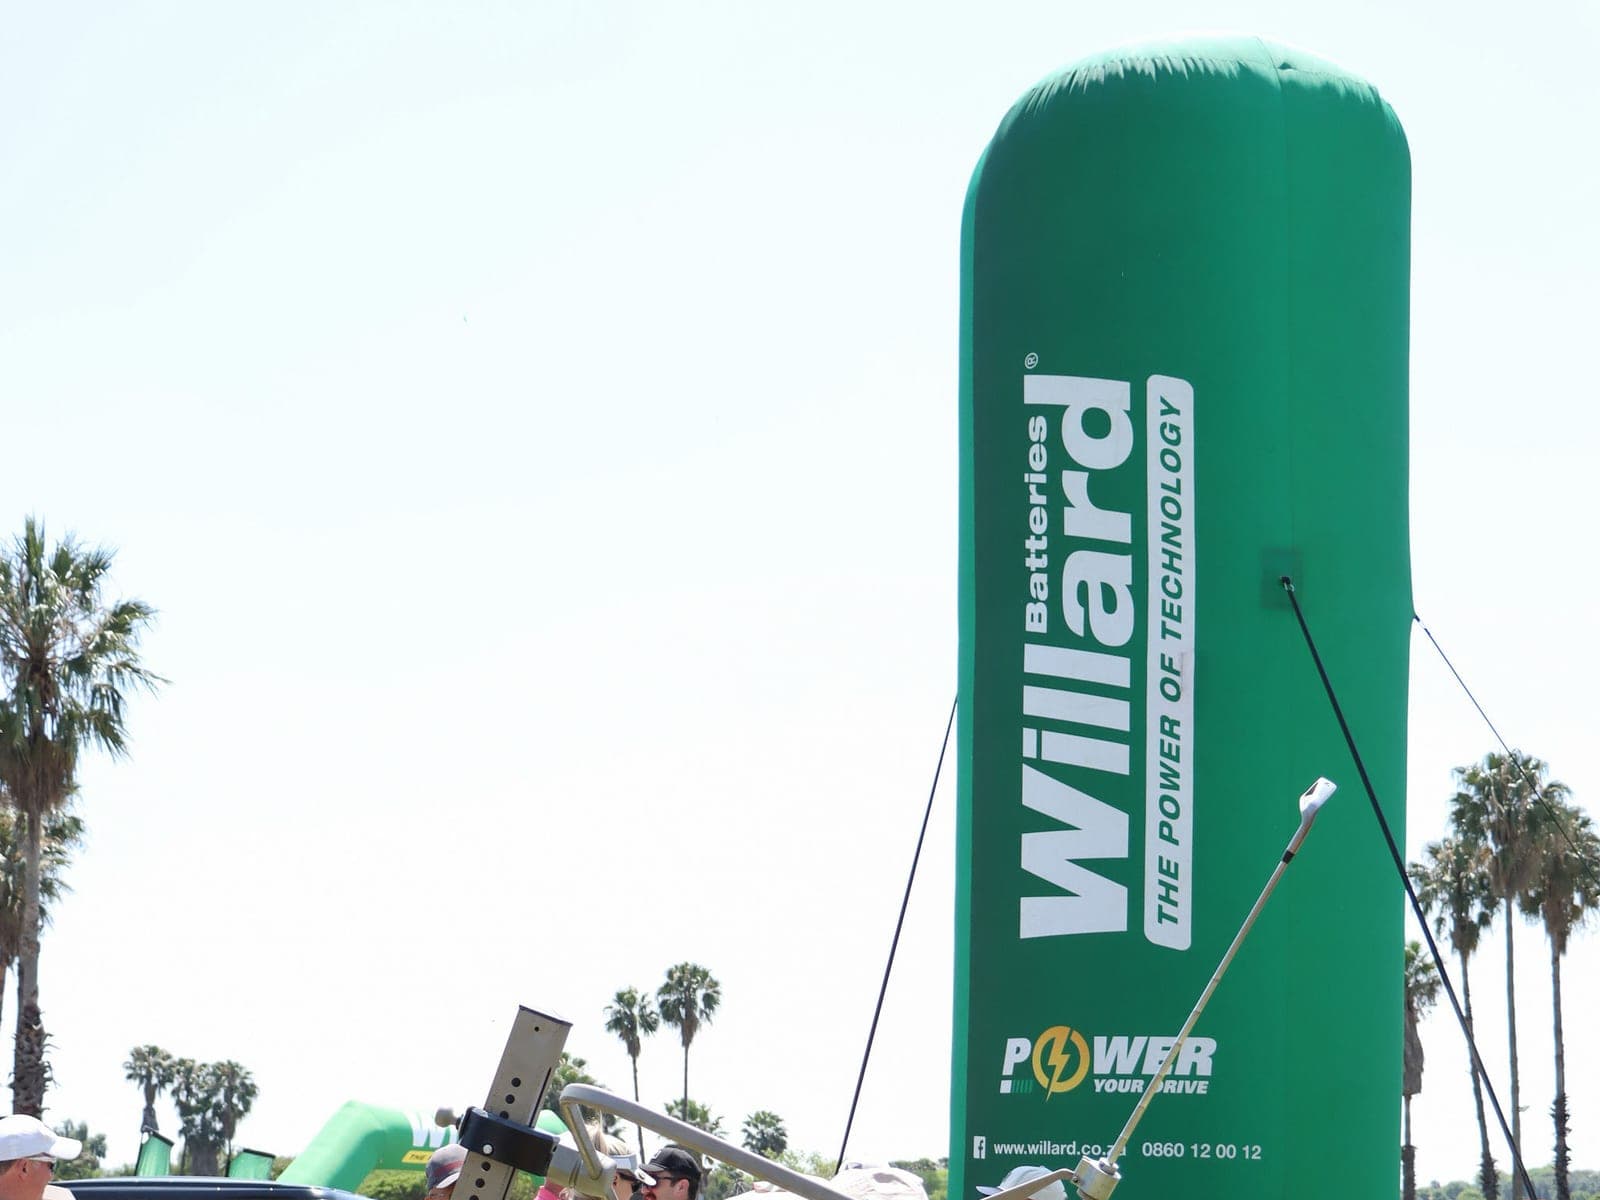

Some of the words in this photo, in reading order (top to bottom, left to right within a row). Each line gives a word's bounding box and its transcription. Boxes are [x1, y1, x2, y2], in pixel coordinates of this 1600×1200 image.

[1023, 414, 1049, 634] Batteries
[1158, 395, 1184, 641] TECHNOLOGY
[1019, 373, 1135, 939] Willard
[1158, 652, 1182, 703] OF
[1157, 714, 1182, 847] POWER
[1156, 855, 1180, 926] THE
[1094, 1078, 1145, 1094] YOUR
[1142, 1142, 1185, 1159] 0860
[1190, 1143, 1211, 1159] 12
[1215, 1144, 1237, 1160] 00
[1242, 1145, 1262, 1160] 12
